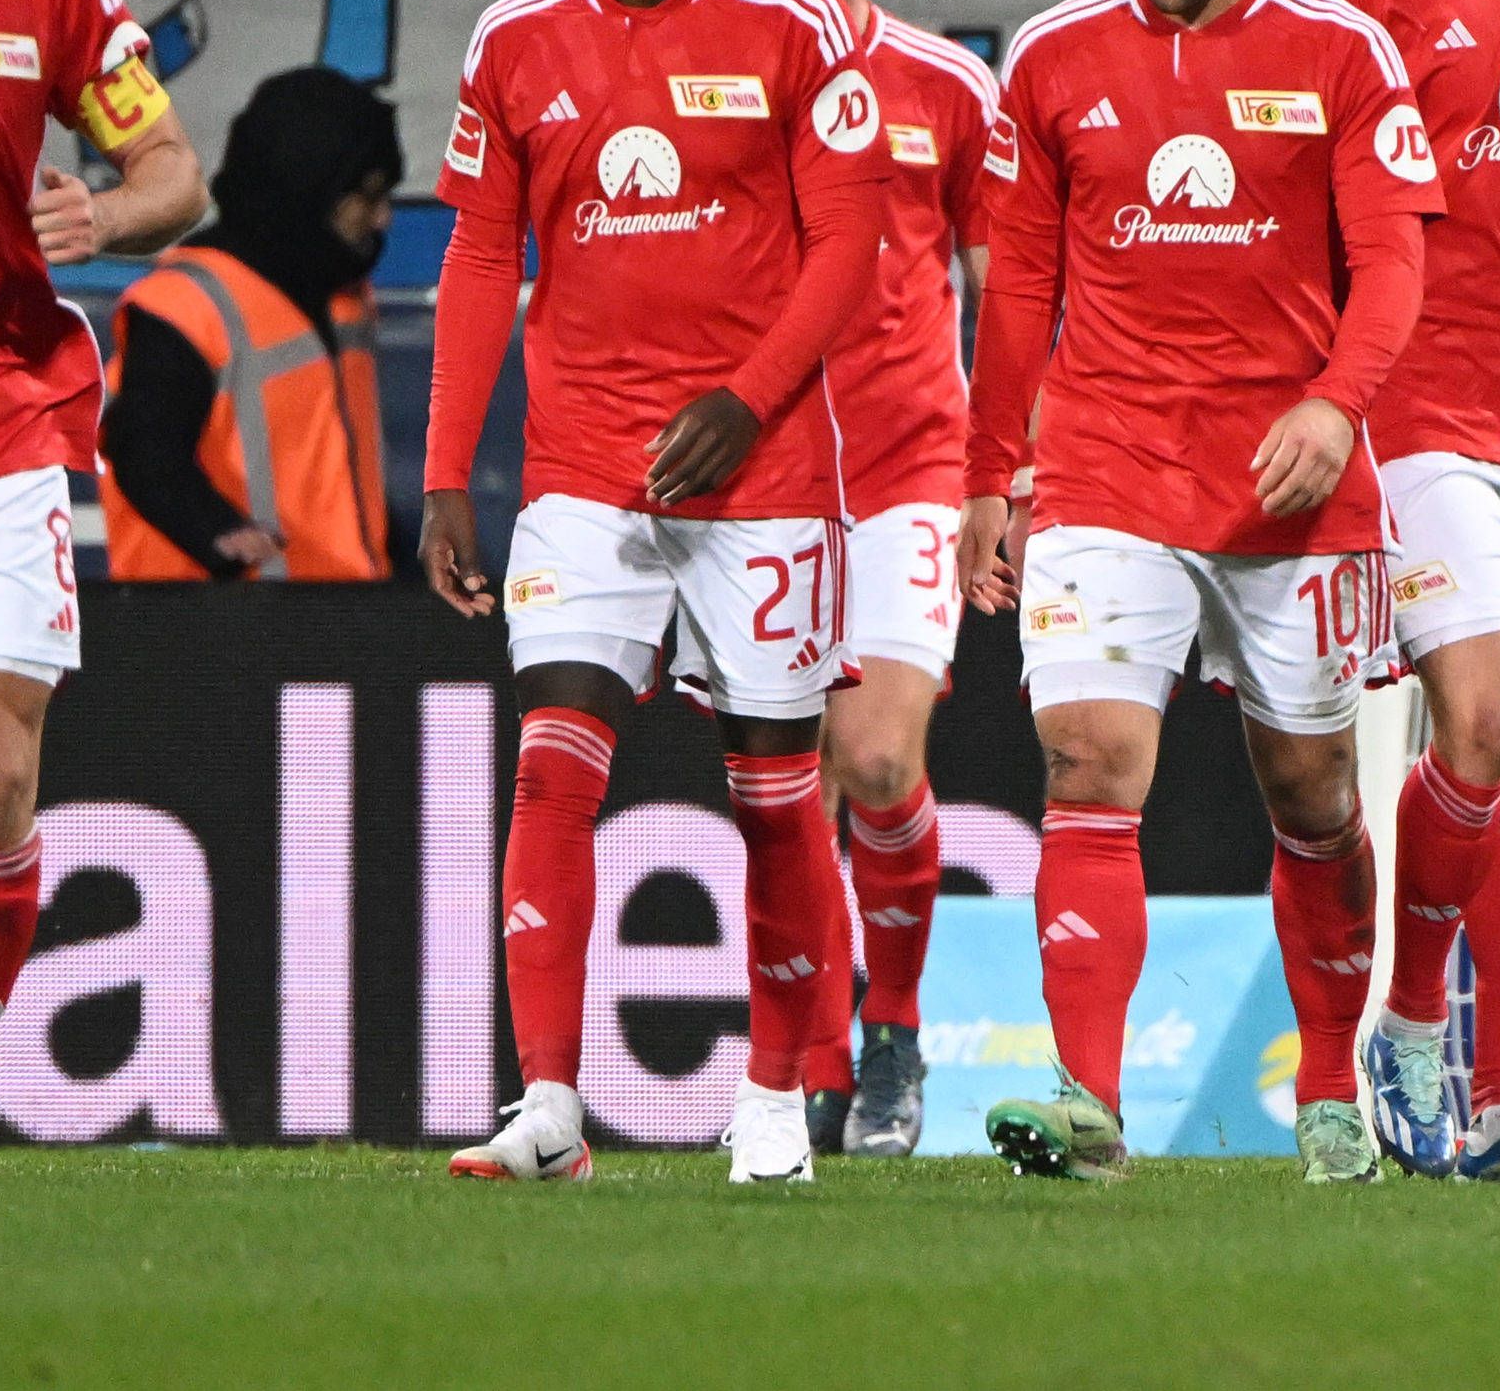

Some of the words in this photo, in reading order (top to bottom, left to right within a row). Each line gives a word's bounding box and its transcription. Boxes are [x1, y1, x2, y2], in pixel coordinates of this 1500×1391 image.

[725, 92, 761, 109] UNION
[827, 87, 869, 136] JD
[1282, 108, 1318, 124] UNION
[1389, 124, 1430, 162] JD
[573, 198, 726, 244] Paramount+
[1109, 204, 1281, 249] Paramount+
[746, 541, 825, 642] 27
[1297, 563, 1361, 658] 10
